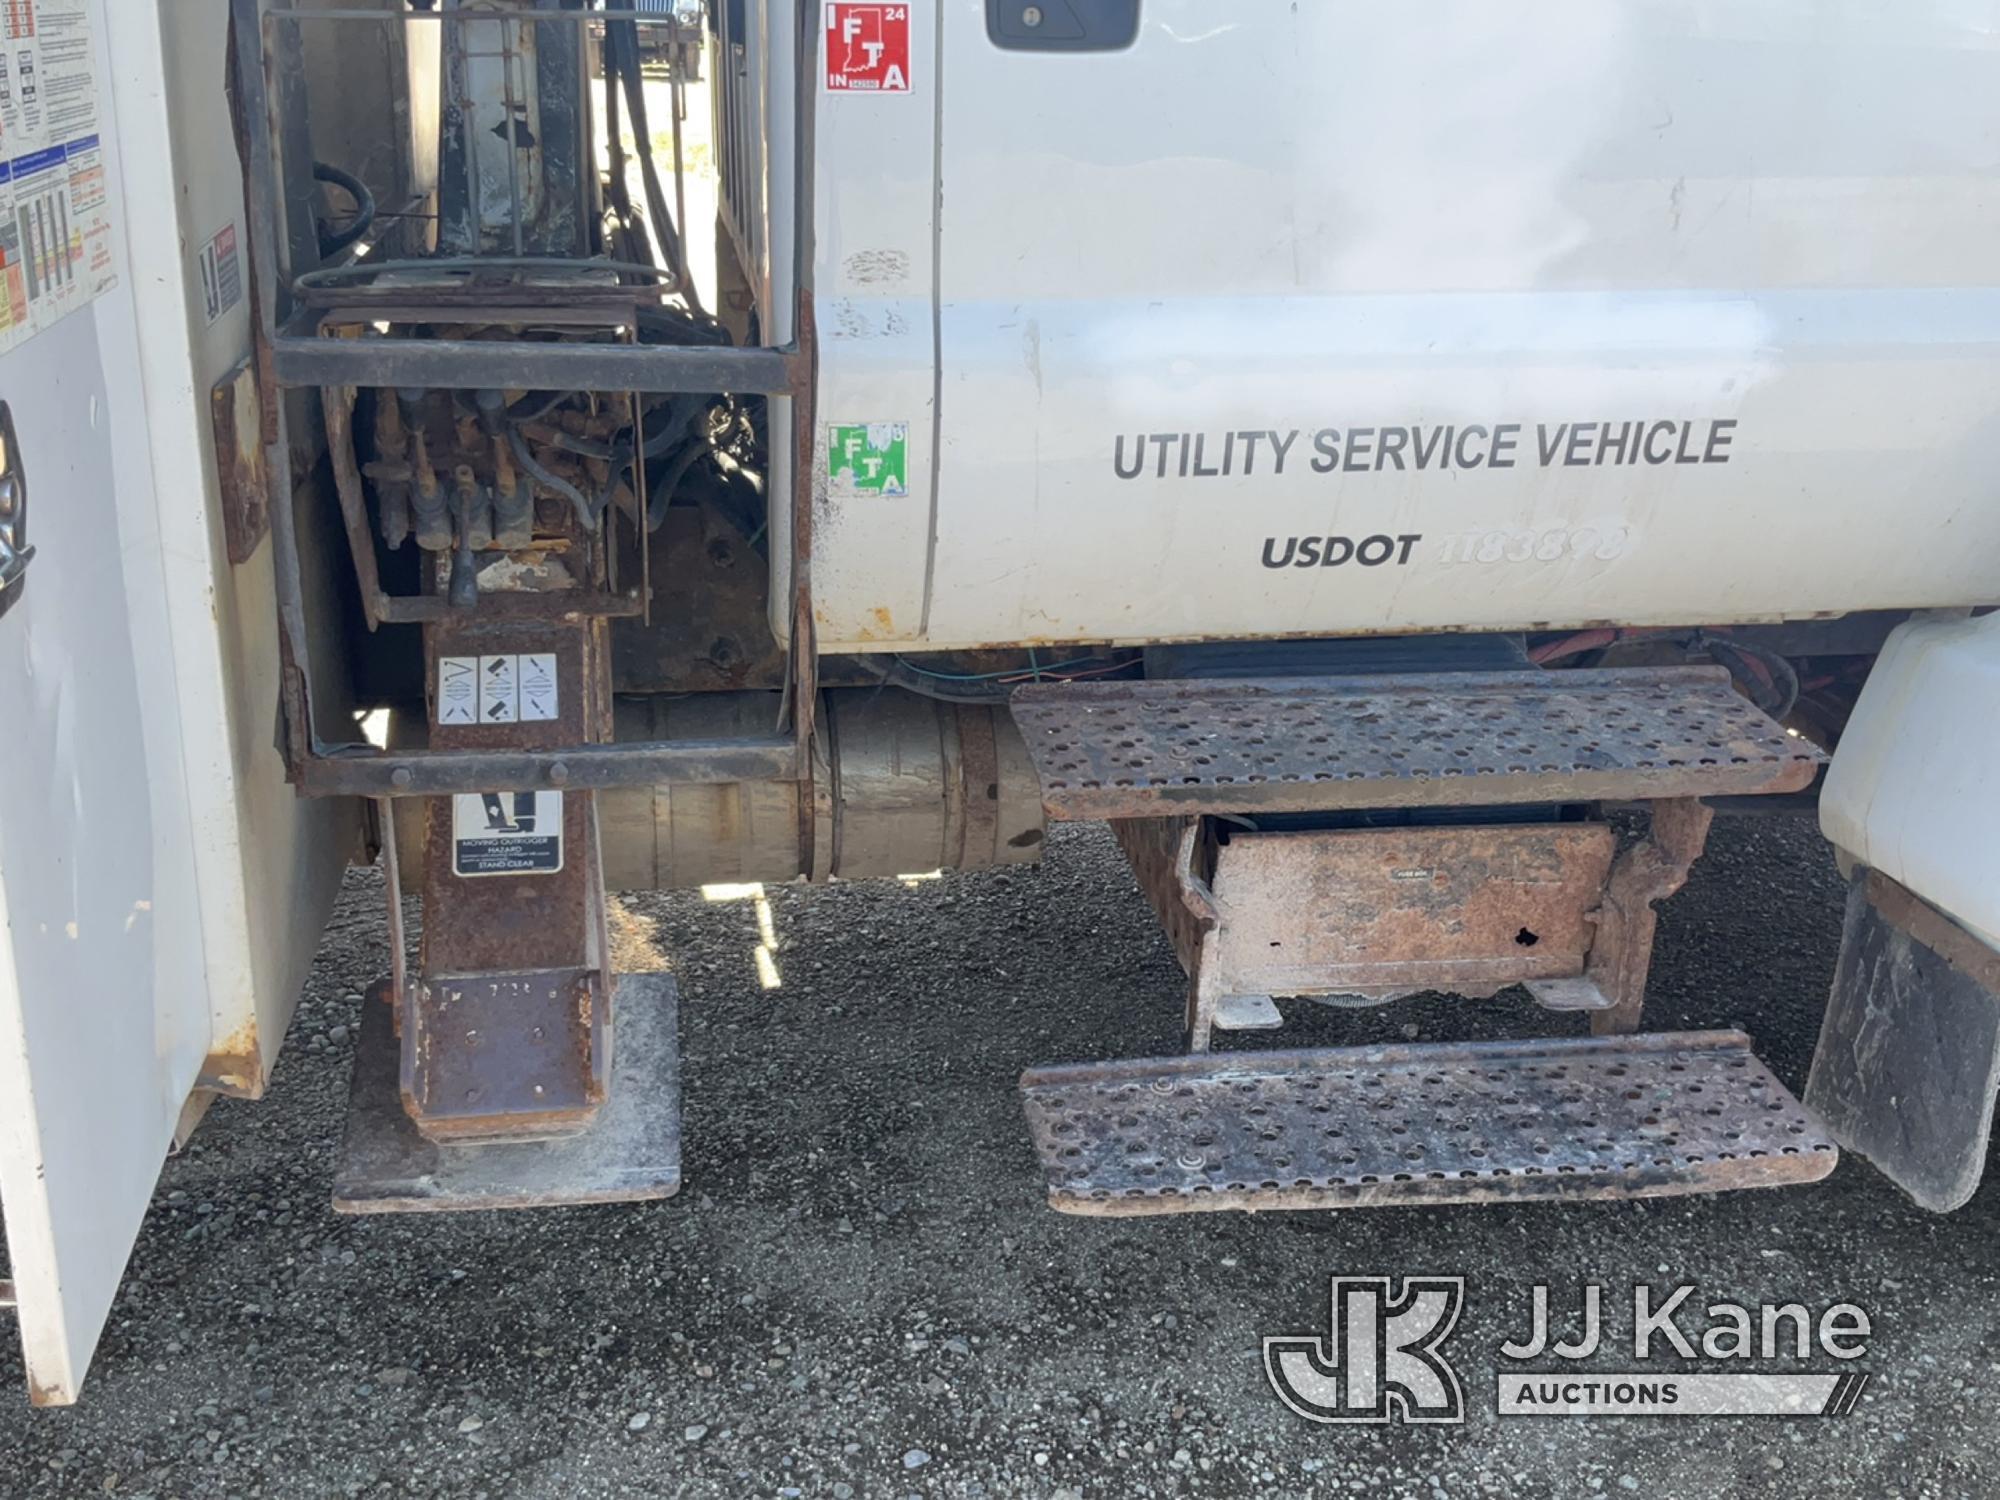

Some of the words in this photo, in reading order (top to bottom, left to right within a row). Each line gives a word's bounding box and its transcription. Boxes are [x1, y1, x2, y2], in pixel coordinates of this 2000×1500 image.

[885, 7, 905, 21] 24
[829, 73, 847, 87] IN
[1114, 429, 1299, 480] UTILITY
[1310, 423, 1521, 475] SERVICE
[1537, 418, 1738, 468] VEHICLE
[1262, 534, 1422, 569] USDOT
[463, 838, 499, 847] MOVING
[500, 837, 548, 847] OUTRIGGER
[488, 846, 523, 854] HAZARD
[478, 860, 507, 869] STAND
[507, 860, 534, 868] CLEAR
